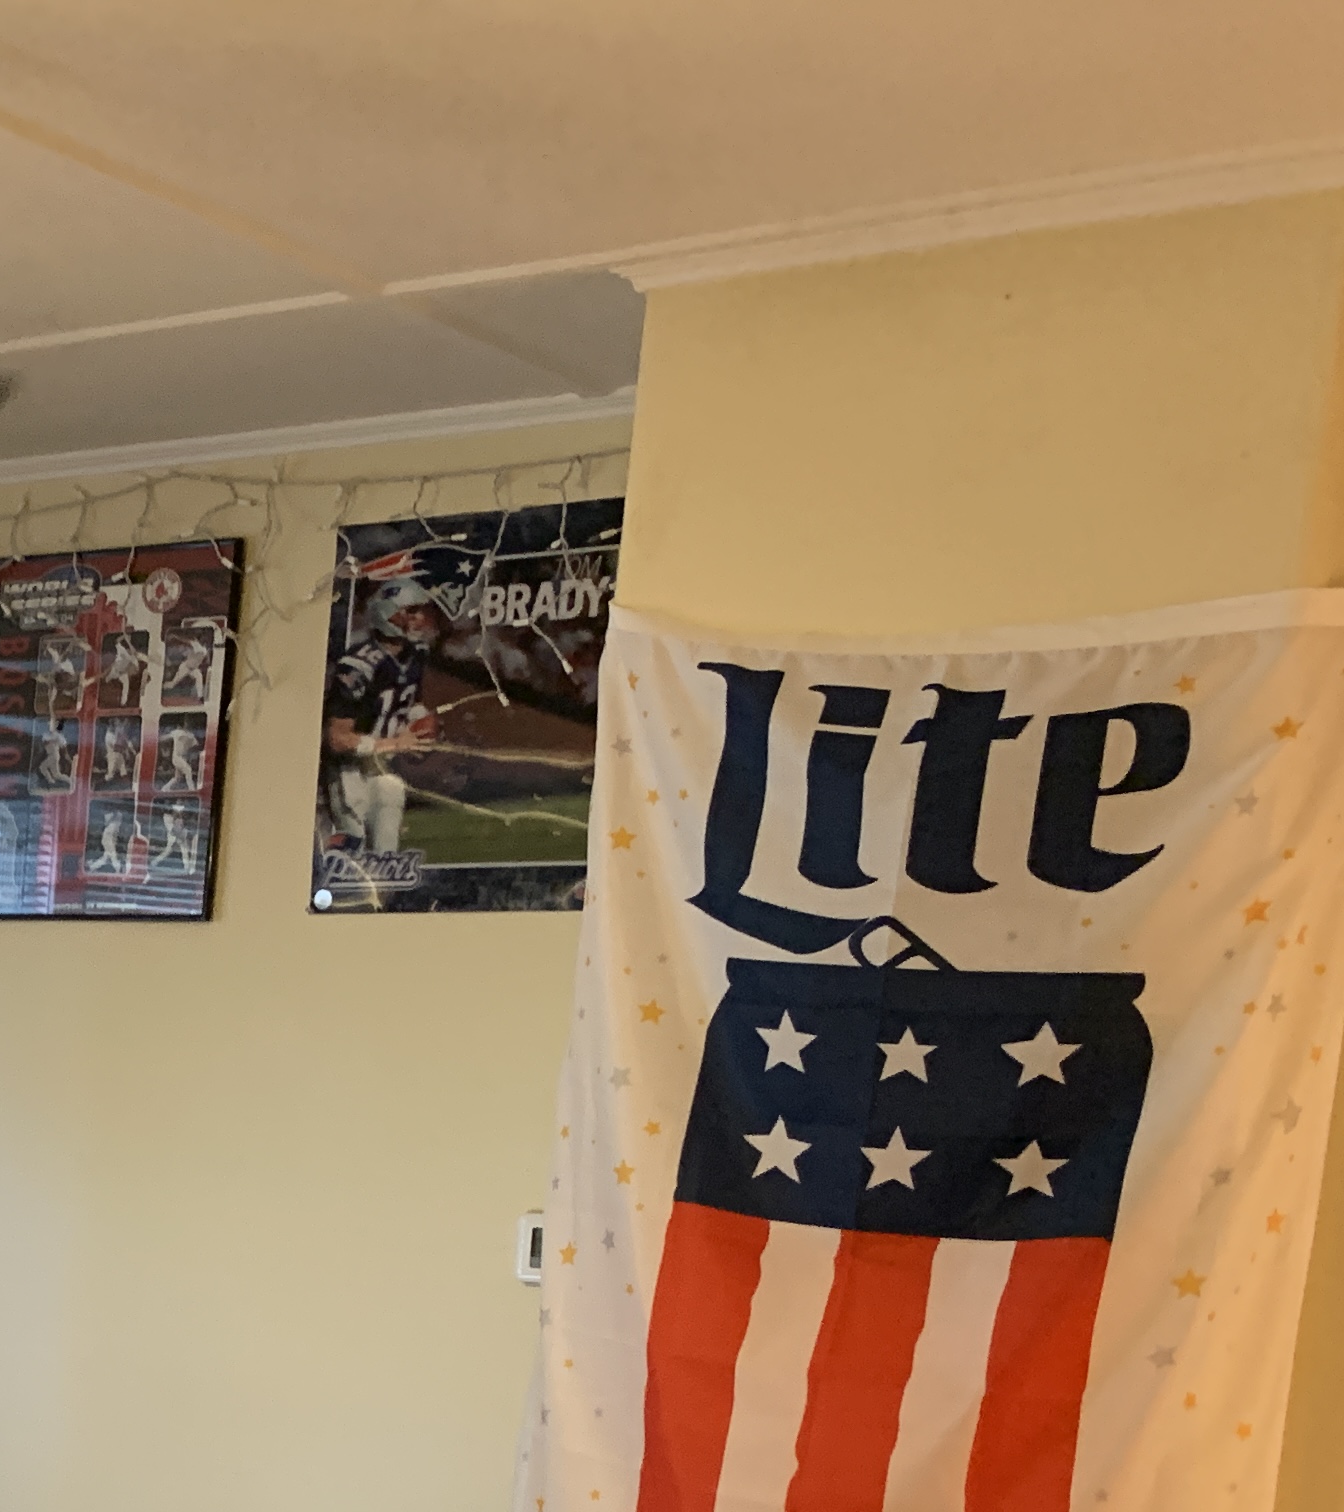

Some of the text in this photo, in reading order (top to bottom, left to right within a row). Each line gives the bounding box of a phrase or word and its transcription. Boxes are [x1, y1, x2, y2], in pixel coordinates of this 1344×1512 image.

[553, 554, 603, 581] TOM
[481, 576, 611, 626] BRADY
[685, 661, 1192, 955] Lite
